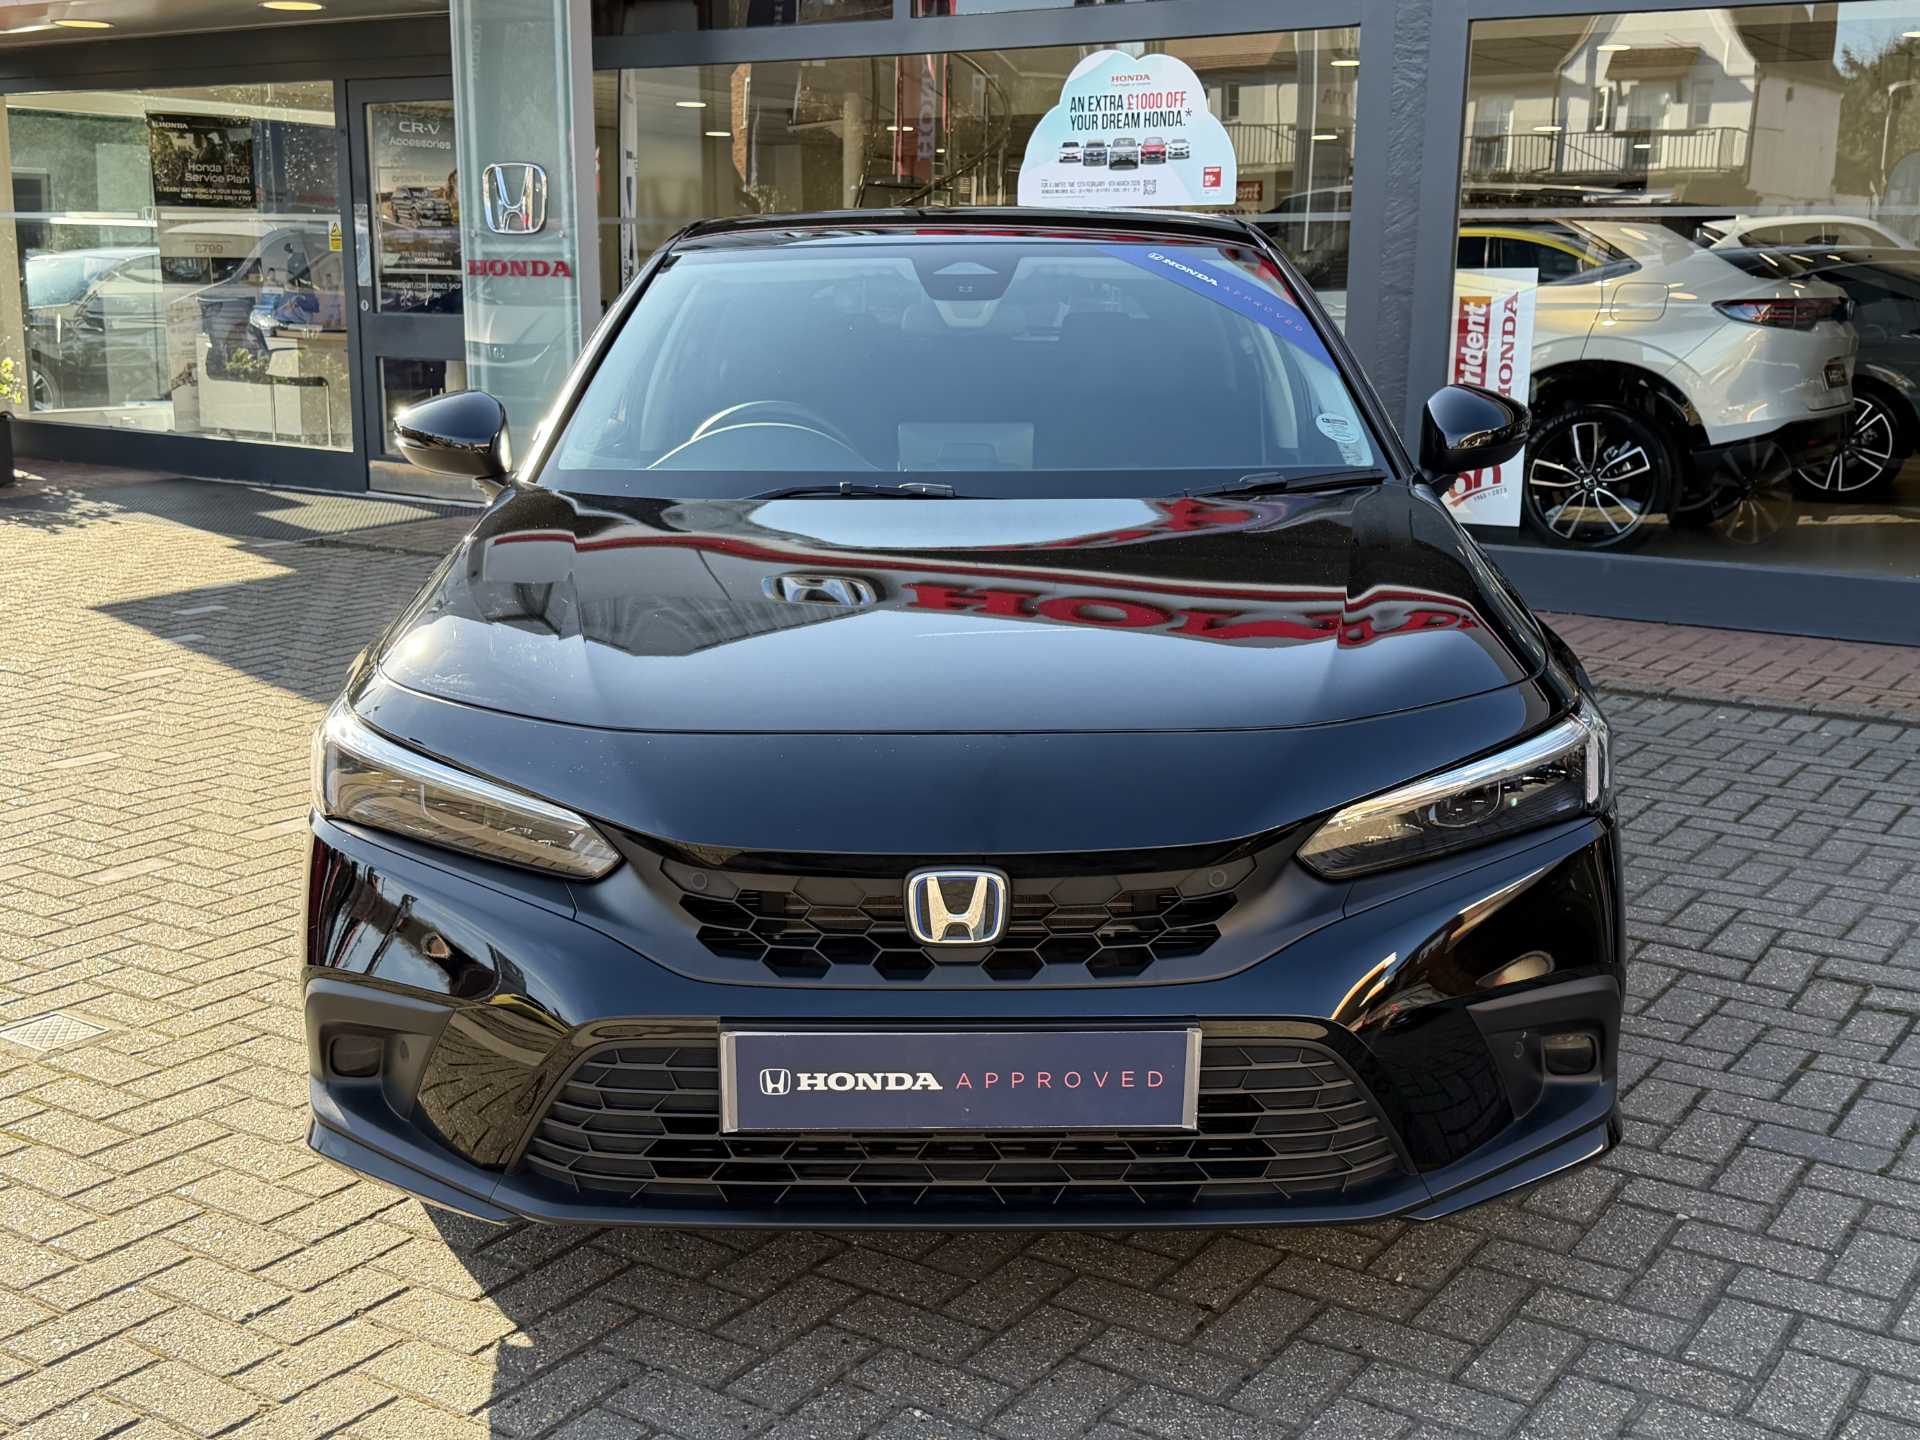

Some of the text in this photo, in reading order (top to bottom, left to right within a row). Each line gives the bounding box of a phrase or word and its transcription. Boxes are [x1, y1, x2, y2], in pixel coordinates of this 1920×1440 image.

[1111, 74, 1151, 82] HONDA
[1070, 91, 1187, 113] AN EXTRA £1000 OFF
[1070, 114, 1098, 131] YOUR
[1101, 112, 1141, 130] DREAM
[389, 136, 452, 150] Accessories
[188, 159, 222, 173] Honda
[184, 173, 250, 184] Service Plan
[467, 260, 574, 277] HONDA
[1163, 258, 1218, 287] HONDA
[797, 1072, 943, 1090] HONDA
[956, 1071, 1164, 1088] APPROVED
